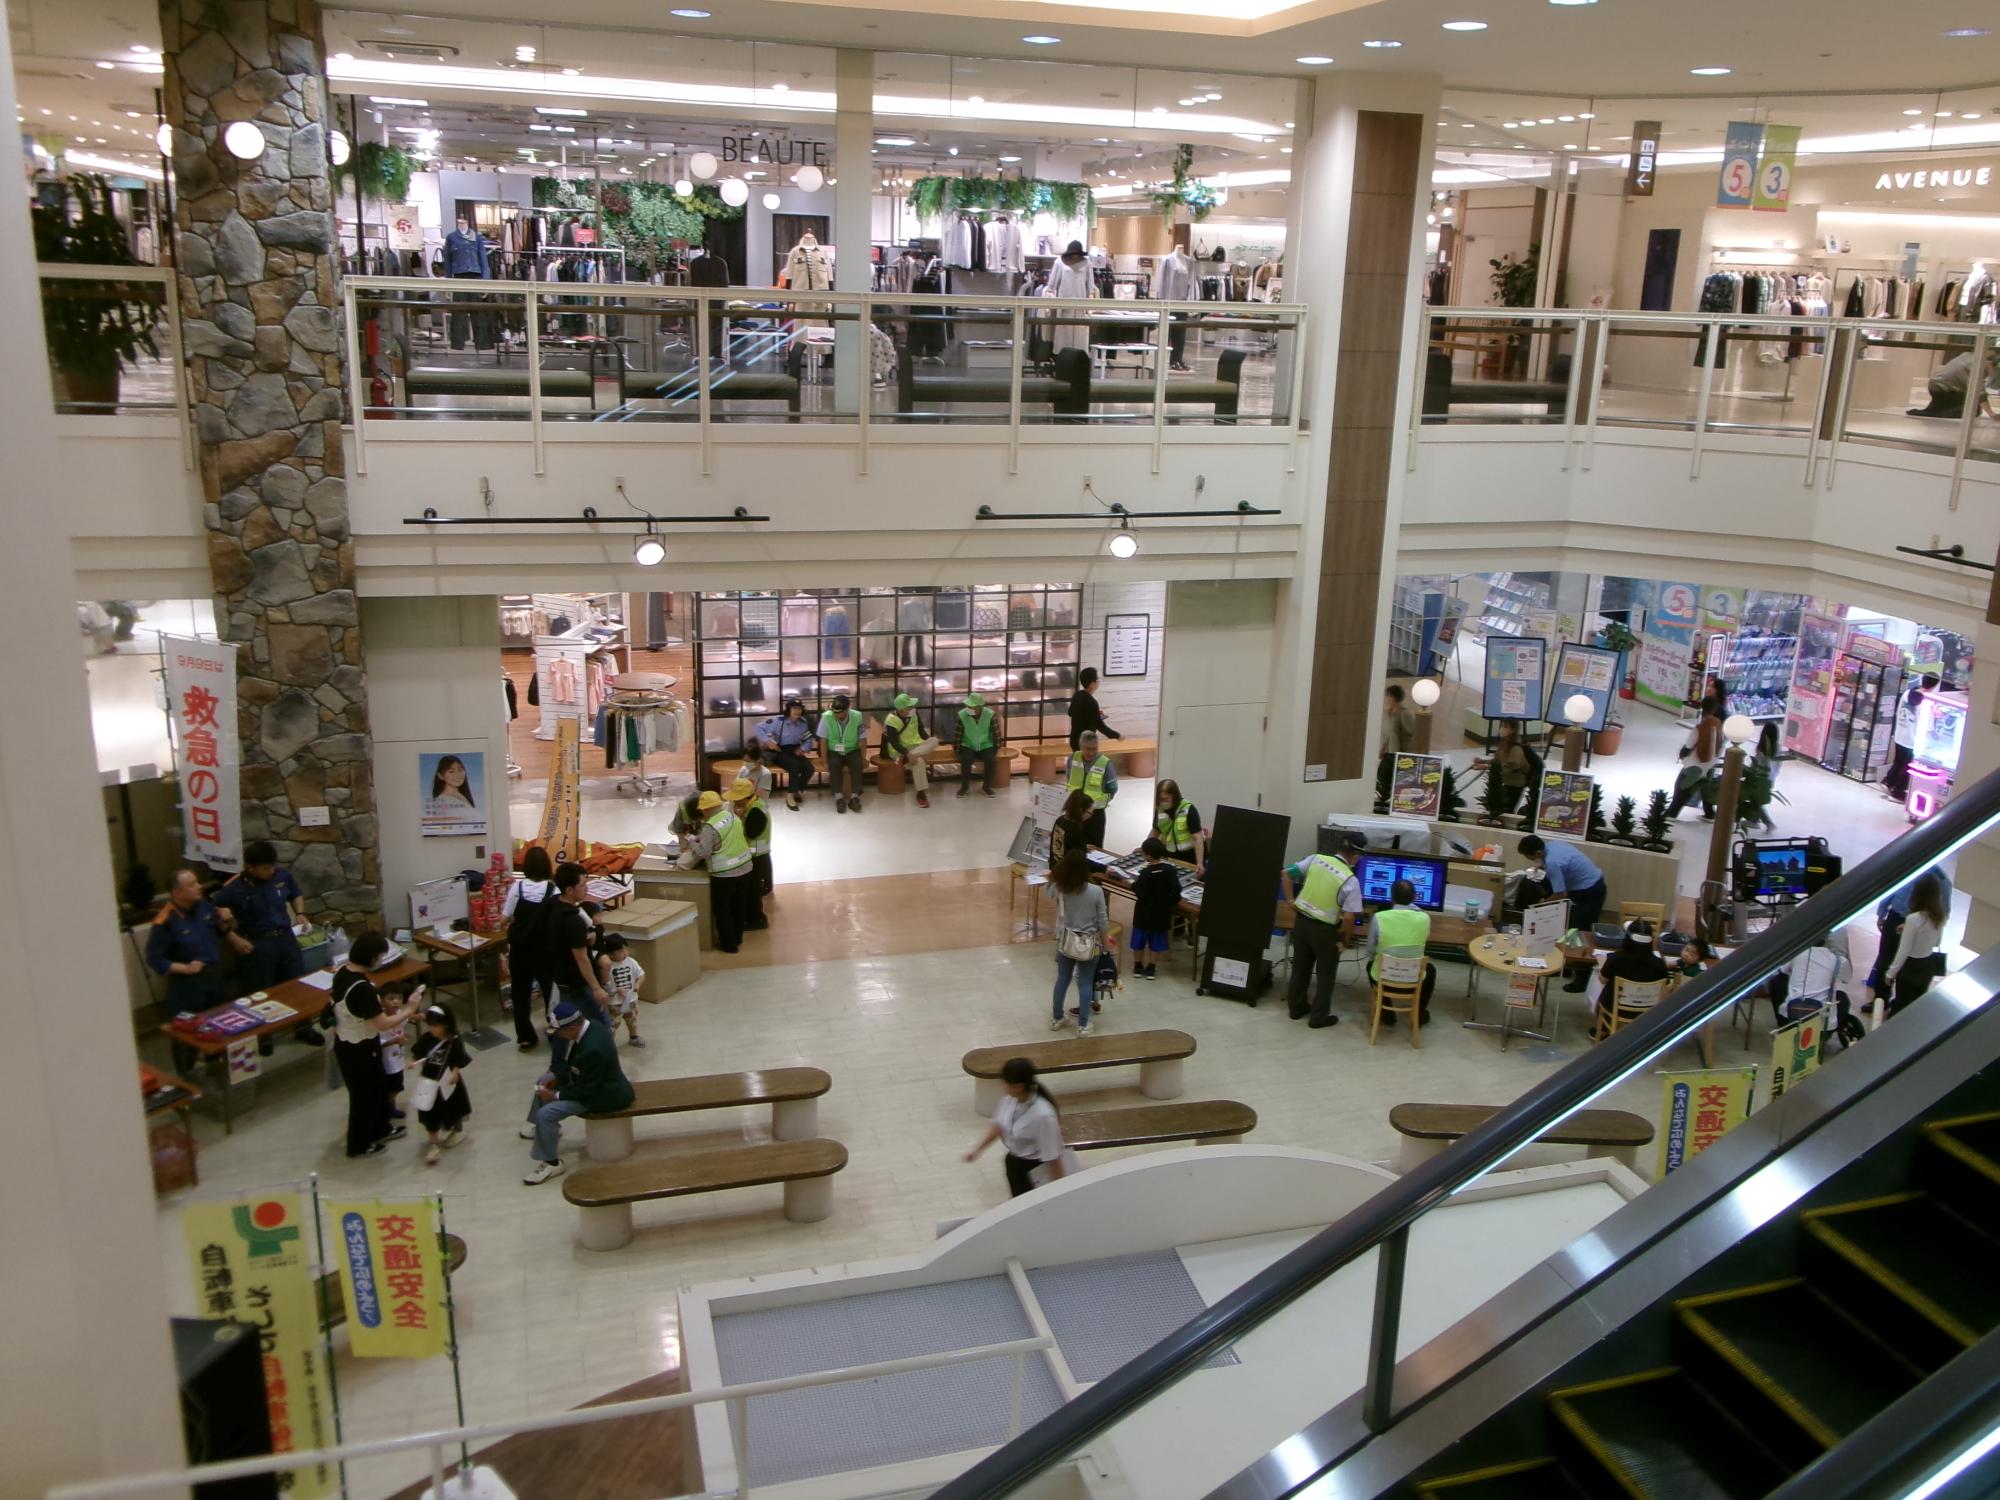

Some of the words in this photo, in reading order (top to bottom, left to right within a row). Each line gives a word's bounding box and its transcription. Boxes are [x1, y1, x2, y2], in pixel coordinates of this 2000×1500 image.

[722, 136, 827, 167] BEAUTE
[1728, 163, 1744, 193] 5
[1766, 165, 1782, 194] 3
[1874, 167, 1991, 189] AVENUE
[1671, 588, 1687, 613] 5
[183, 685, 221, 844] 救急の日
